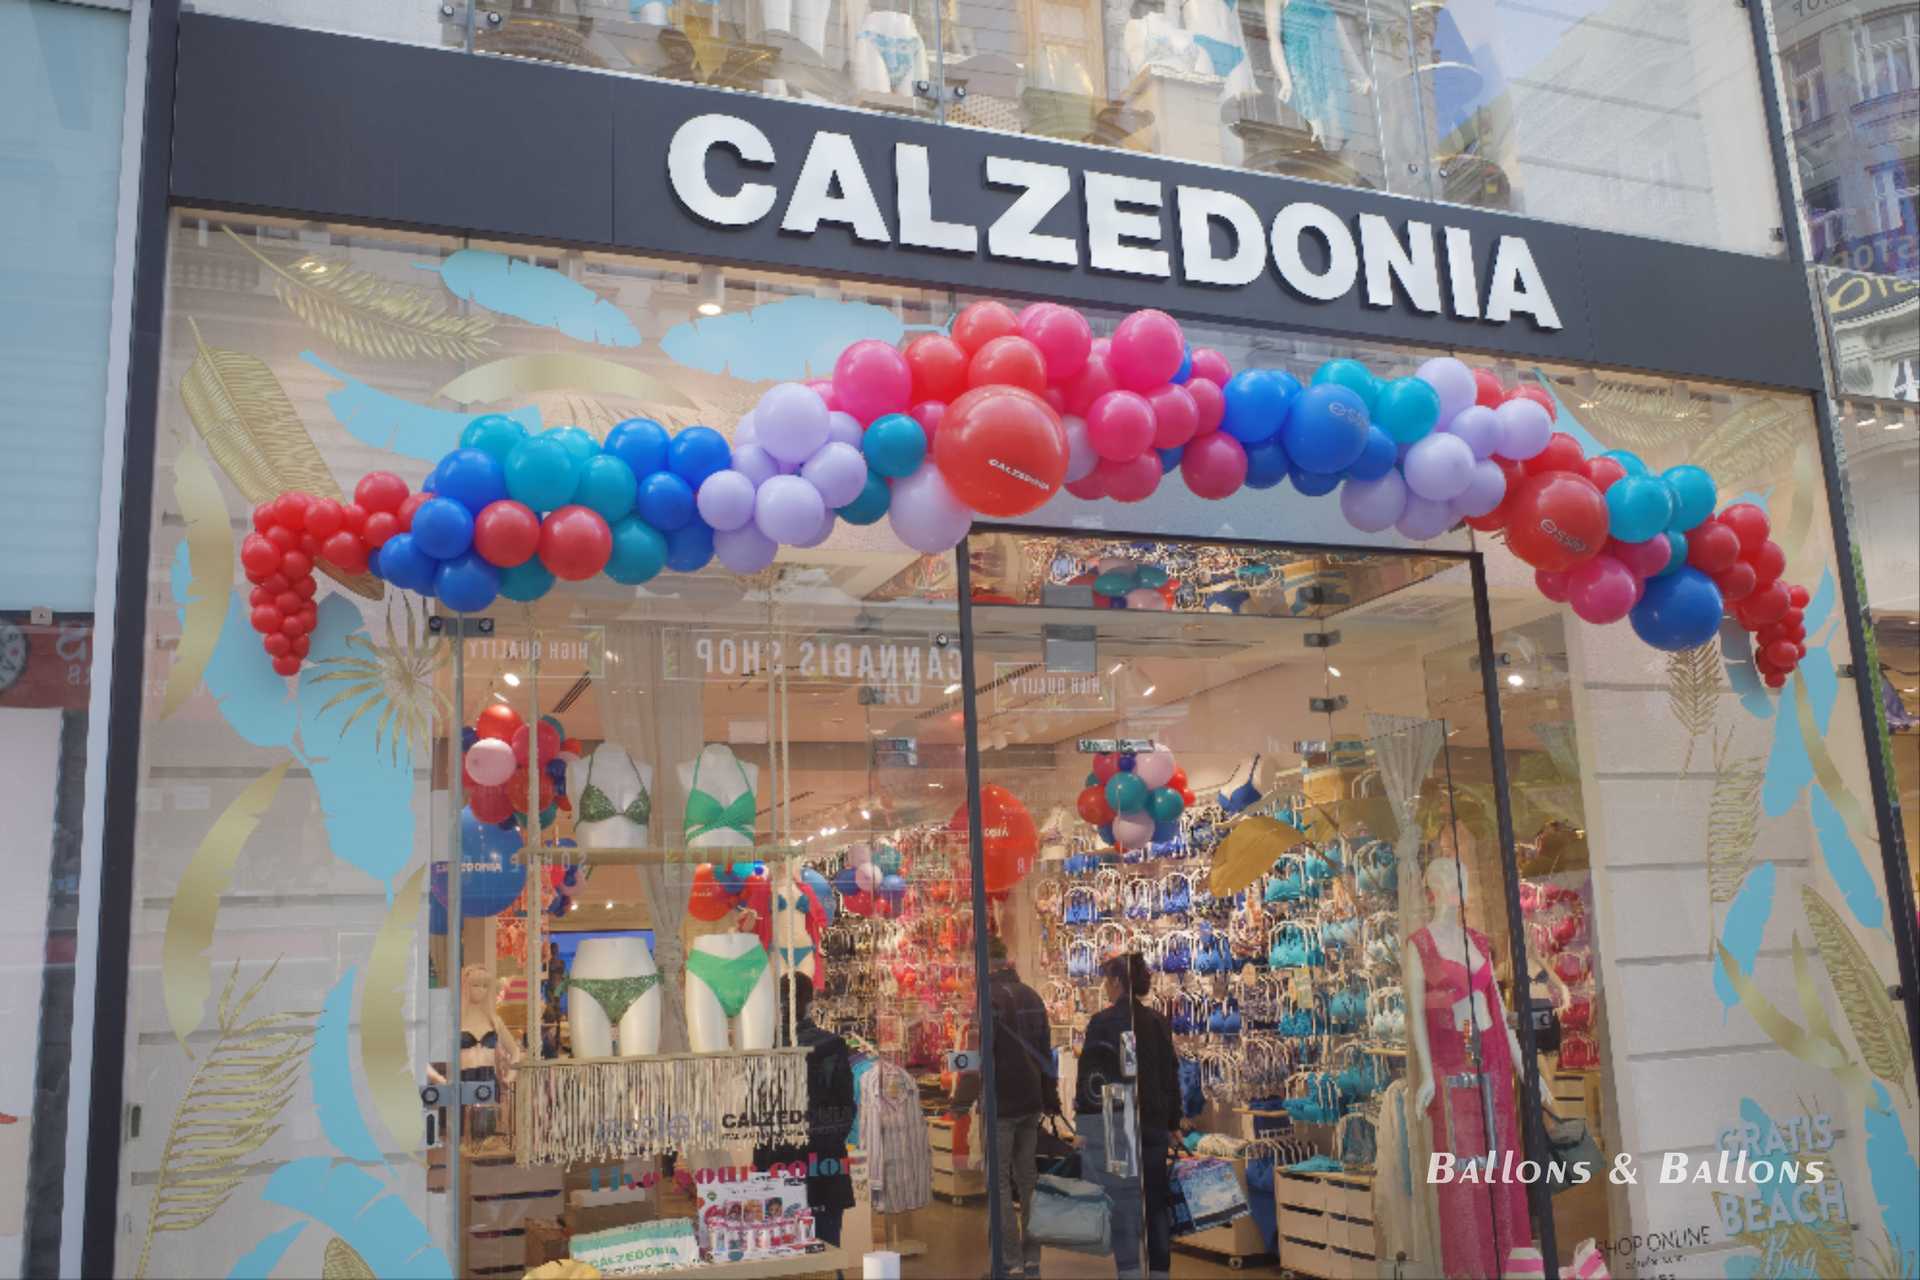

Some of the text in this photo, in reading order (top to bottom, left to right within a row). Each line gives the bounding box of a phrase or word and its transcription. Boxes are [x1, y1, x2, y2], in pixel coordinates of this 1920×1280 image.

[668, 113, 1563, 330] CALZEDONIA
[1715, 1113, 1837, 1160] GRATIS
[1721, 1181, 1849, 1236] BEACH
[1595, 1226, 1711, 1259] SHOP ONLINE
